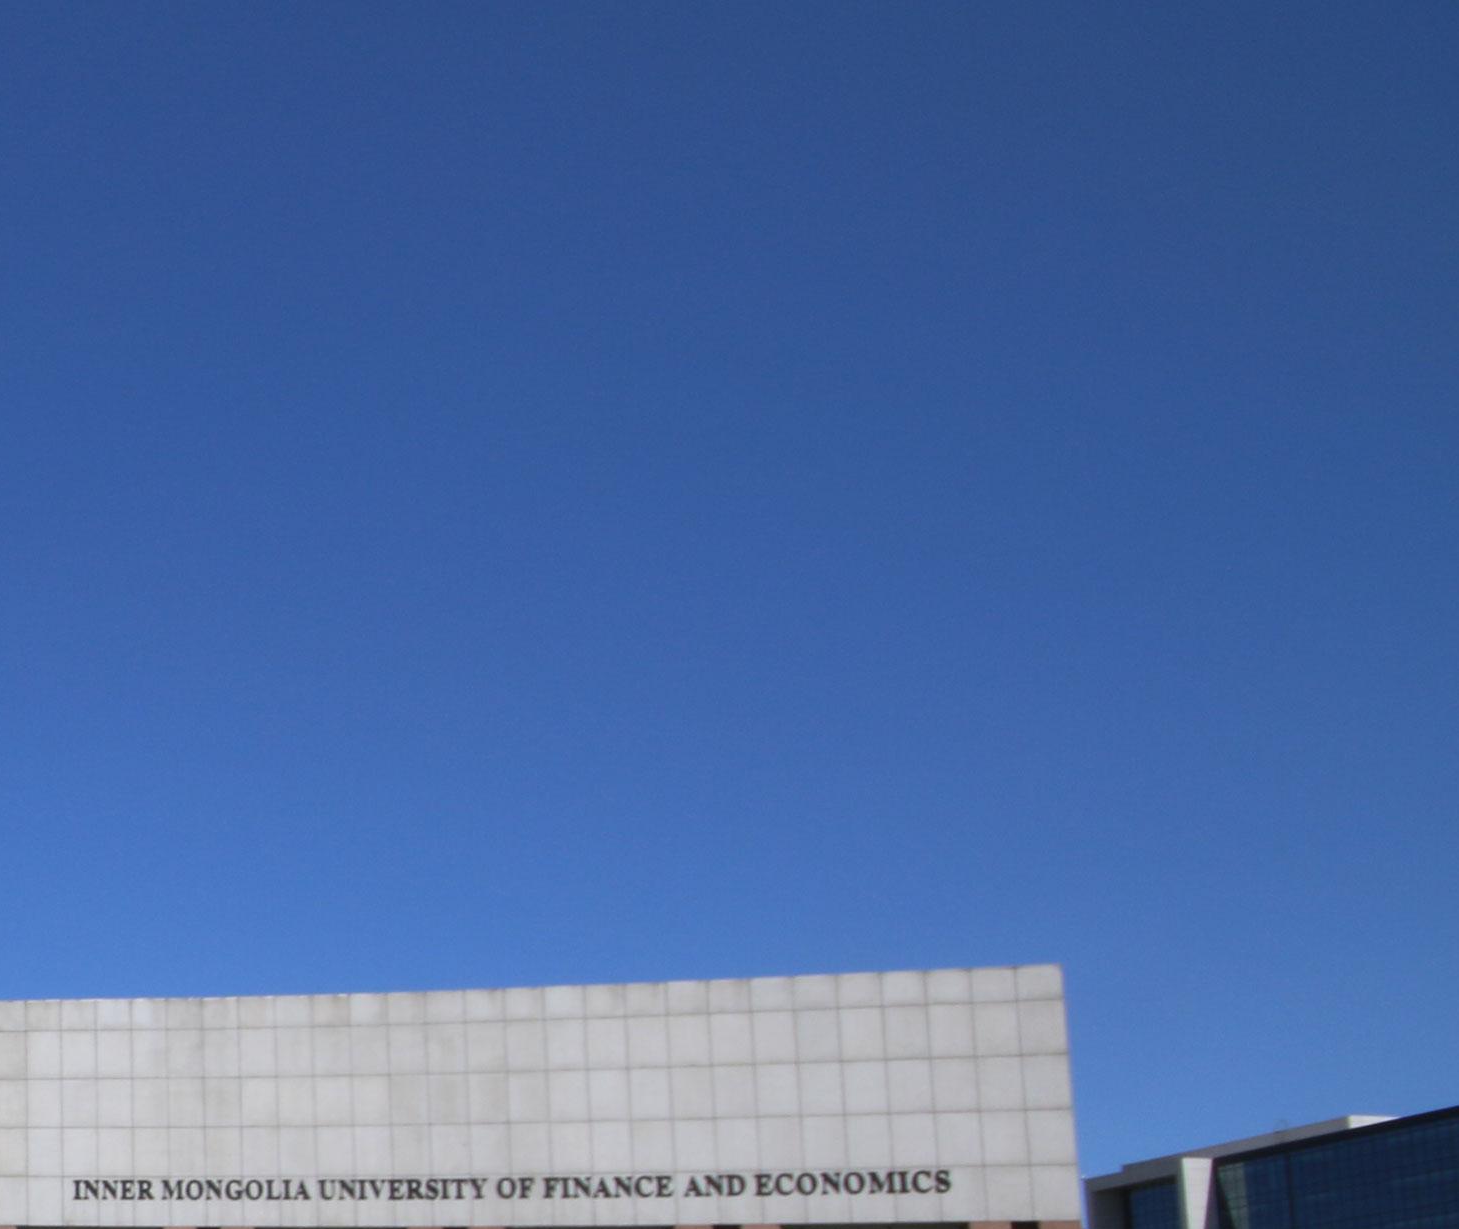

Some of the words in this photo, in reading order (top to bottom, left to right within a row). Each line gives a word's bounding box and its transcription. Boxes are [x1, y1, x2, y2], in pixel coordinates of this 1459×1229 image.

[73, 1179, 155, 1201] INNER
[161, 1178, 311, 1201] MONGOLIA
[317, 1177, 488, 1201] UNIVERSITY
[496, 1177, 535, 1200] OF
[542, 1175, 674, 1199] FINANCE
[683, 1173, 746, 1198] AND
[754, 1169, 952, 1196] ECONOMICS
